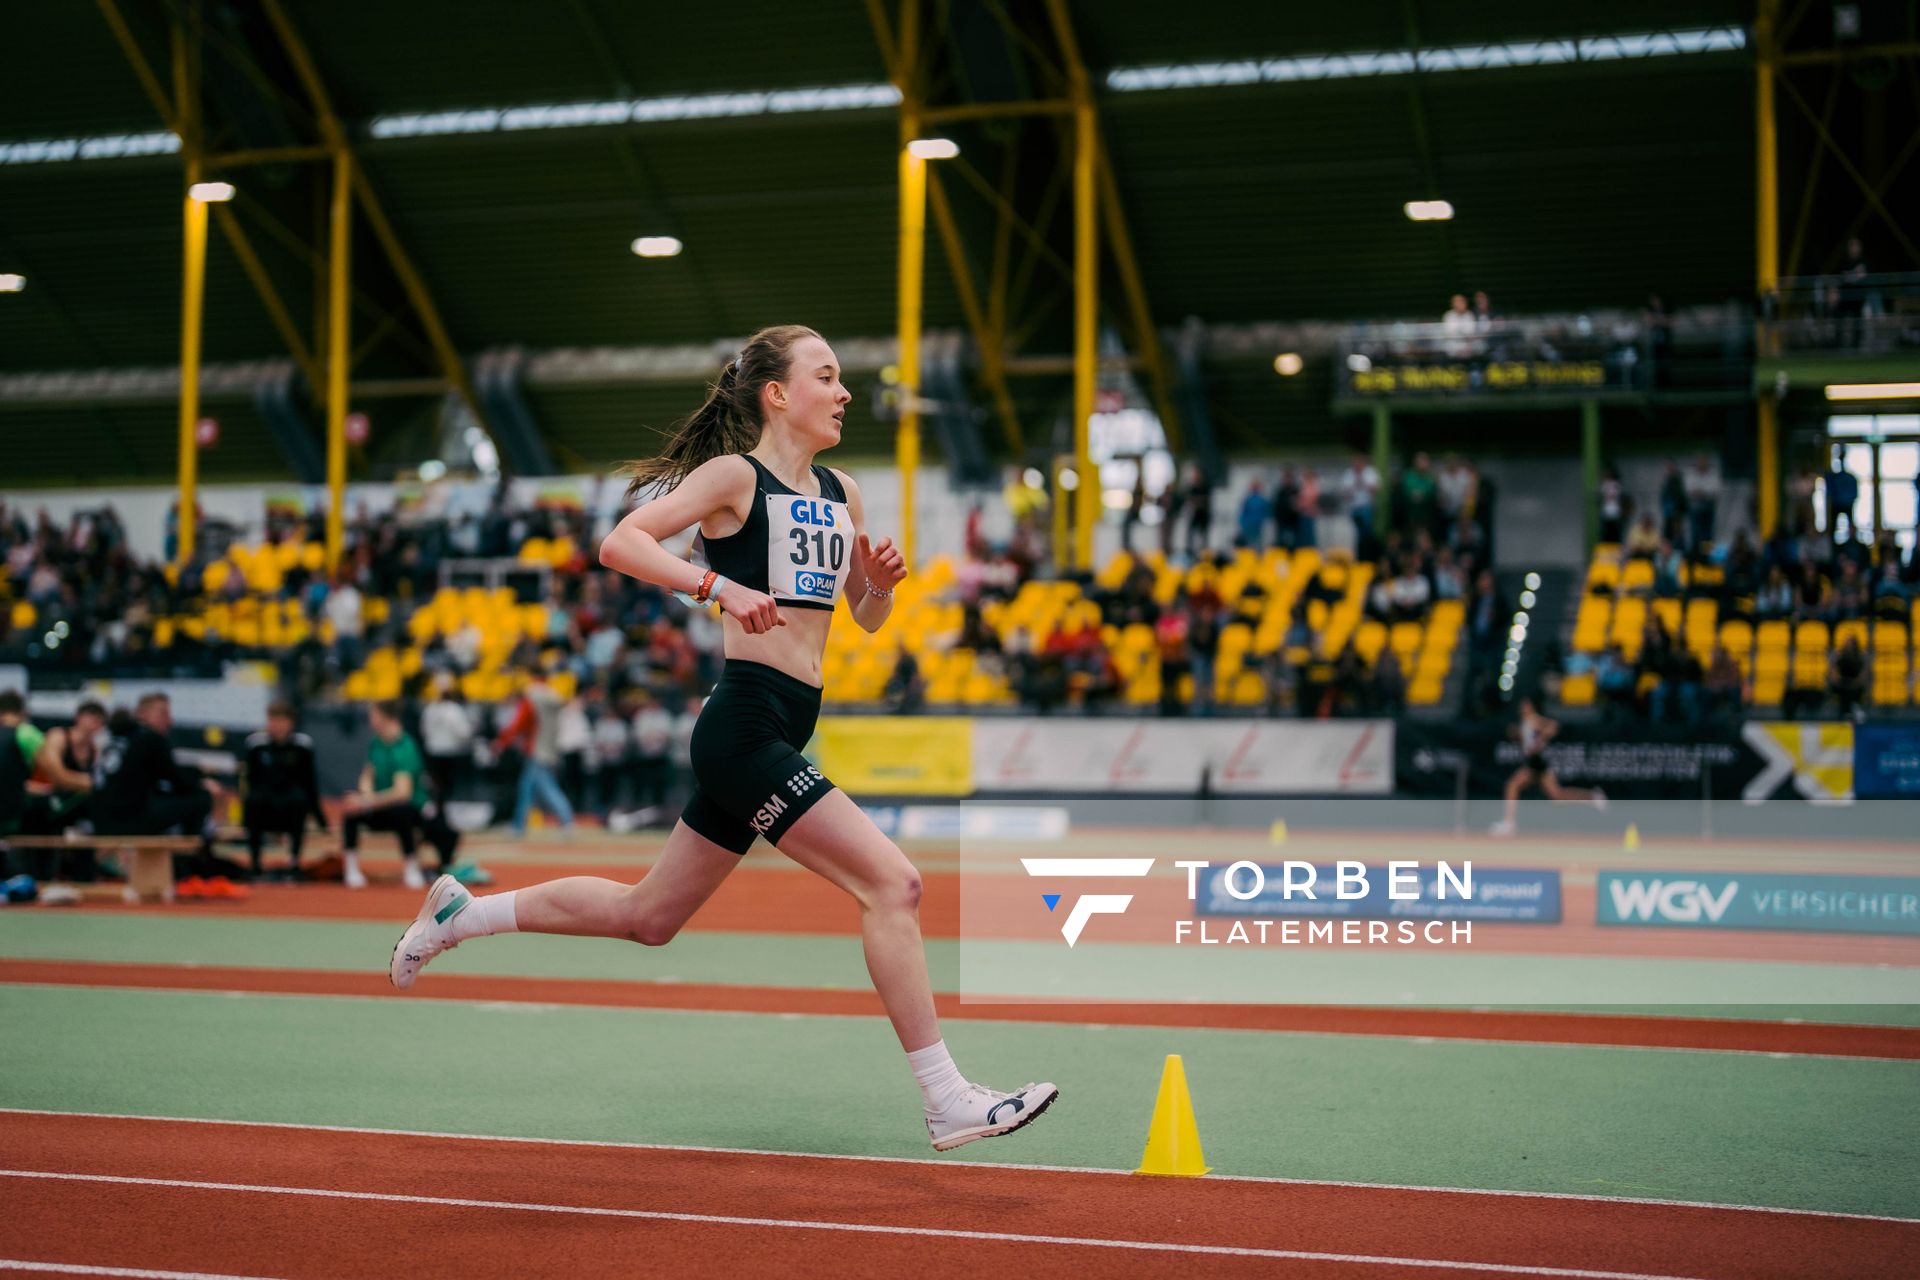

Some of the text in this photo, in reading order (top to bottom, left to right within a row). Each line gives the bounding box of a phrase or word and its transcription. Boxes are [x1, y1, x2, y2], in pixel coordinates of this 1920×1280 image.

[790, 499, 835, 528] GLS
[789, 527, 845, 571] 310
[1609, 879, 1739, 922] WGV
